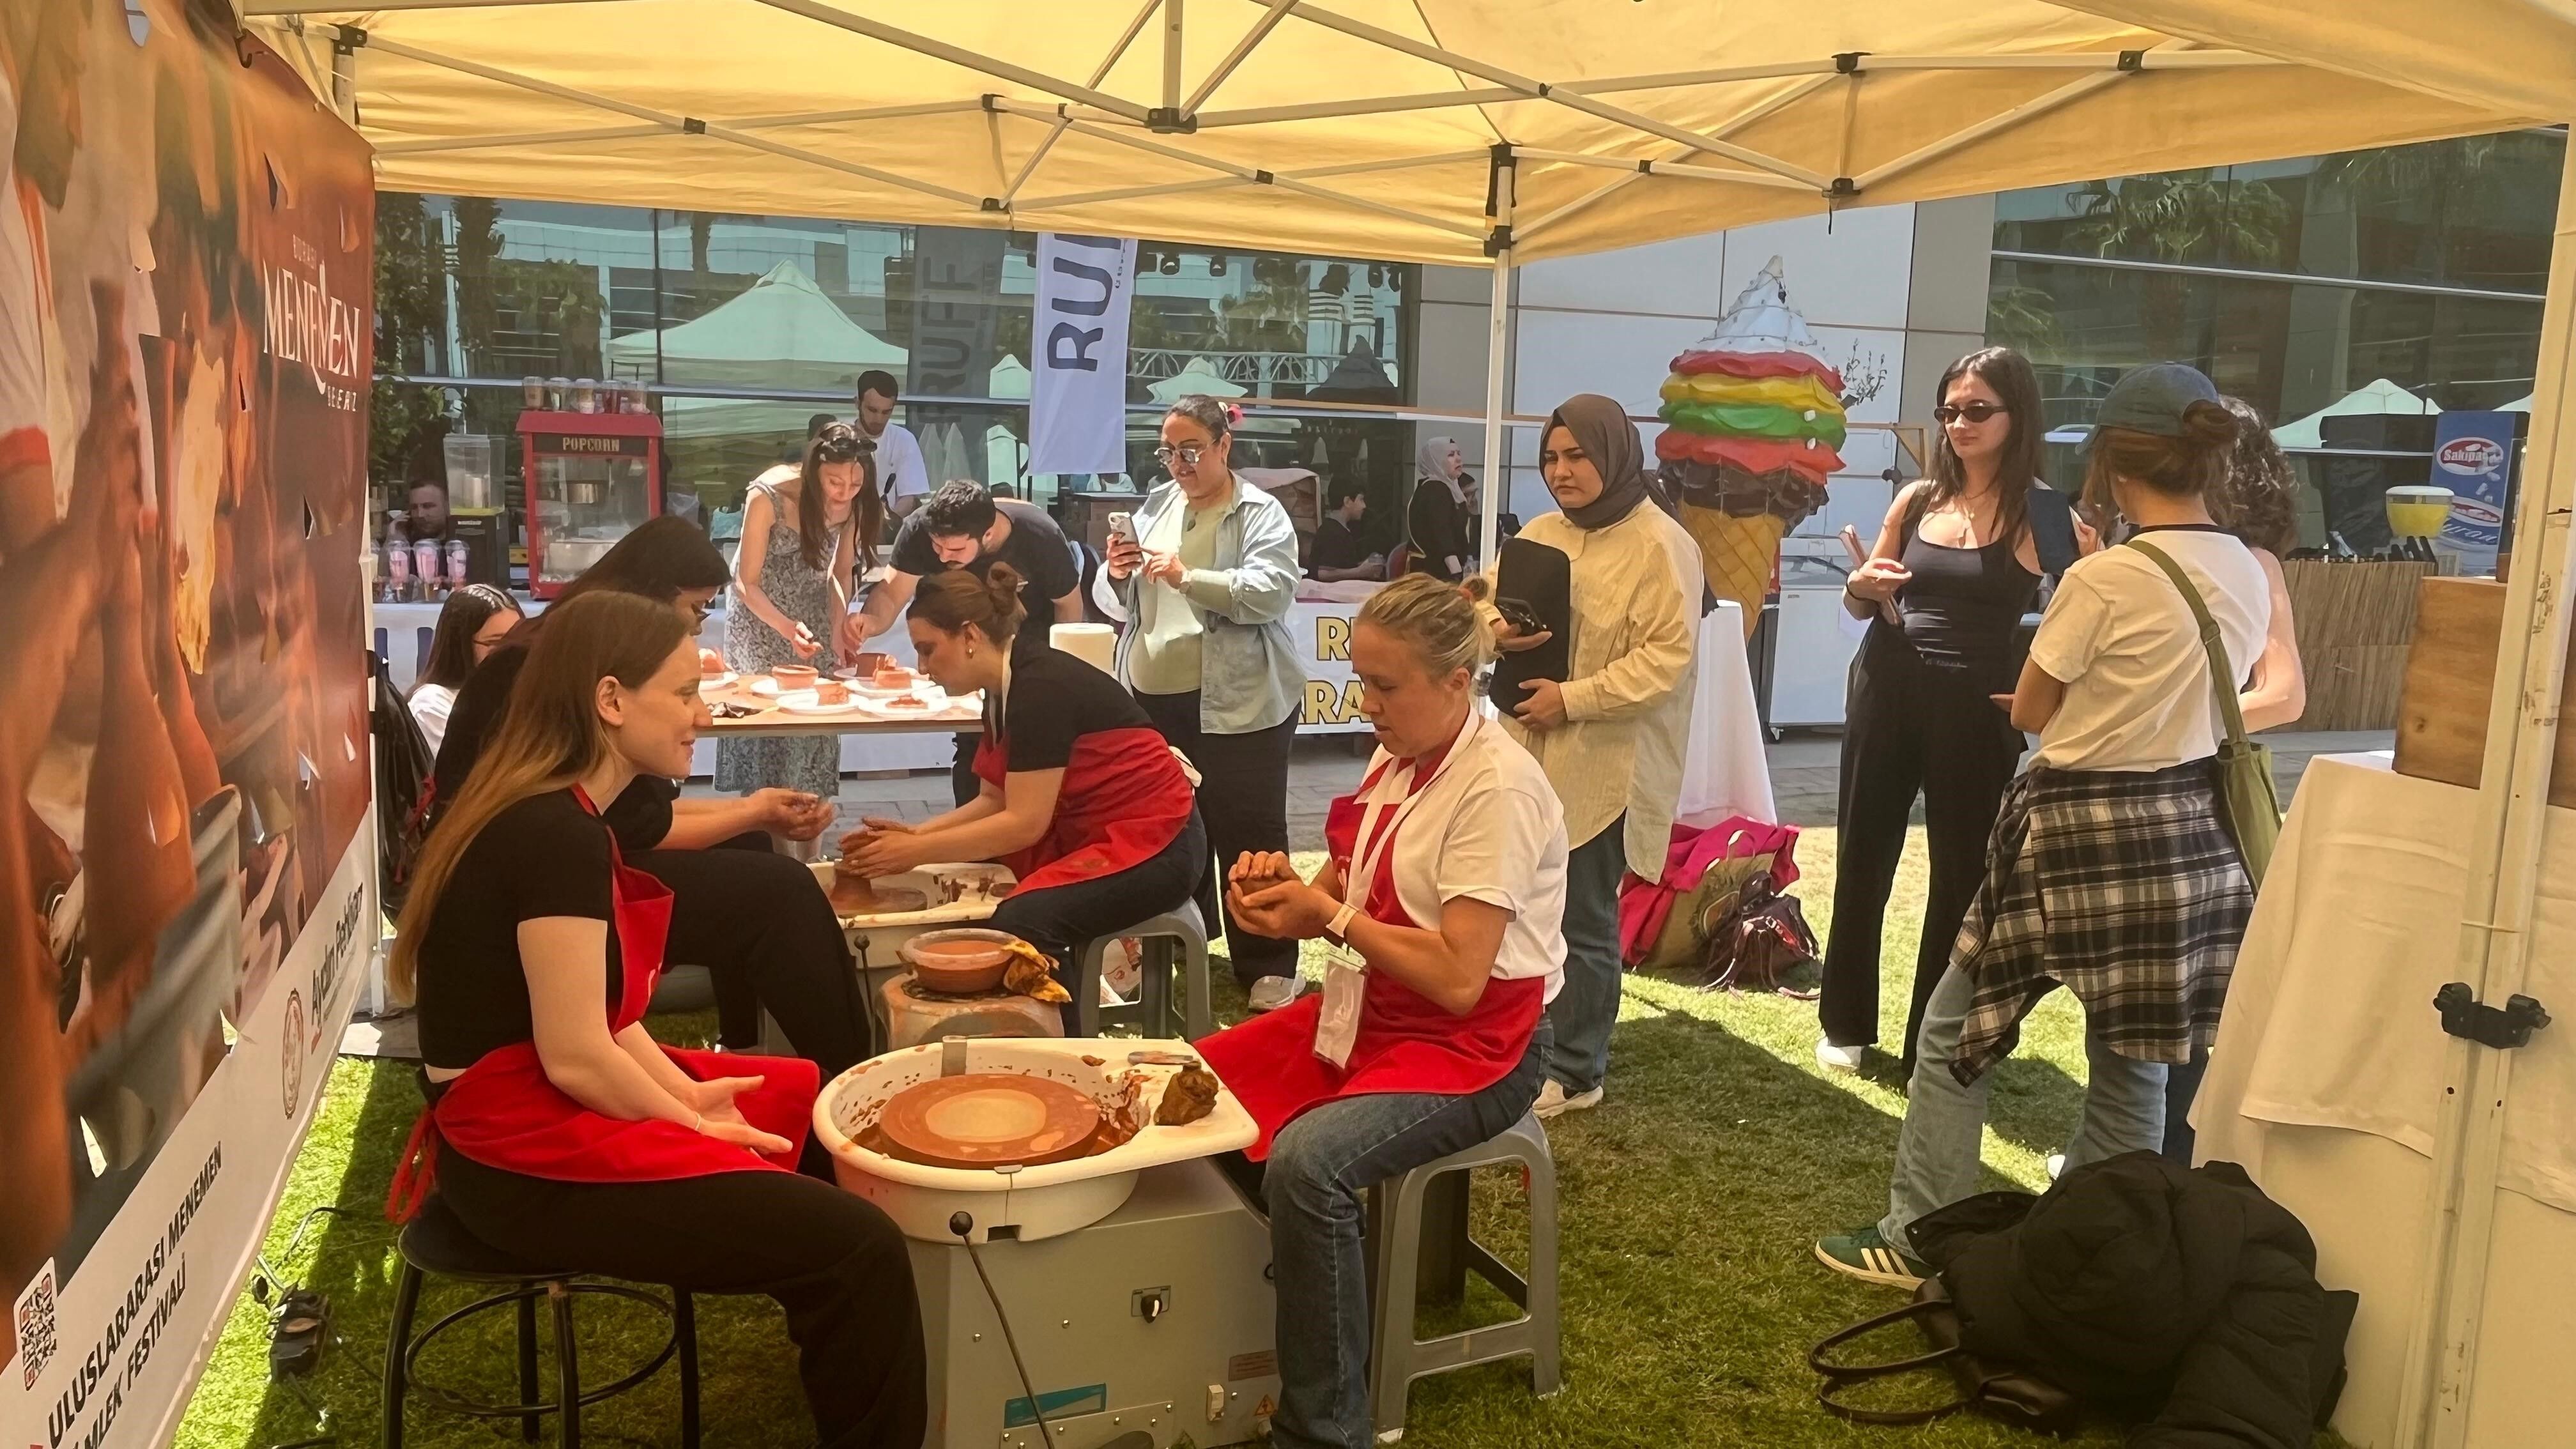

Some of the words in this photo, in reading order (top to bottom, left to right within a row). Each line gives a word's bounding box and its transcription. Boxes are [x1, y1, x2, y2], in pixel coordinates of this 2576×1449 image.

[263, 257, 360, 394] MENEMEN
[1047, 233, 1121, 372] RU
[562, 437, 620, 452] POPCORN
[1316, 617, 1353, 661] R
[49, 1236, 165, 1449] ULUSLARARASI
[169, 1140, 222, 1257] MENEMEN
[73, 1370, 123, 1449] MLEK
[128, 1252, 186, 1392] FESTİVALİ
